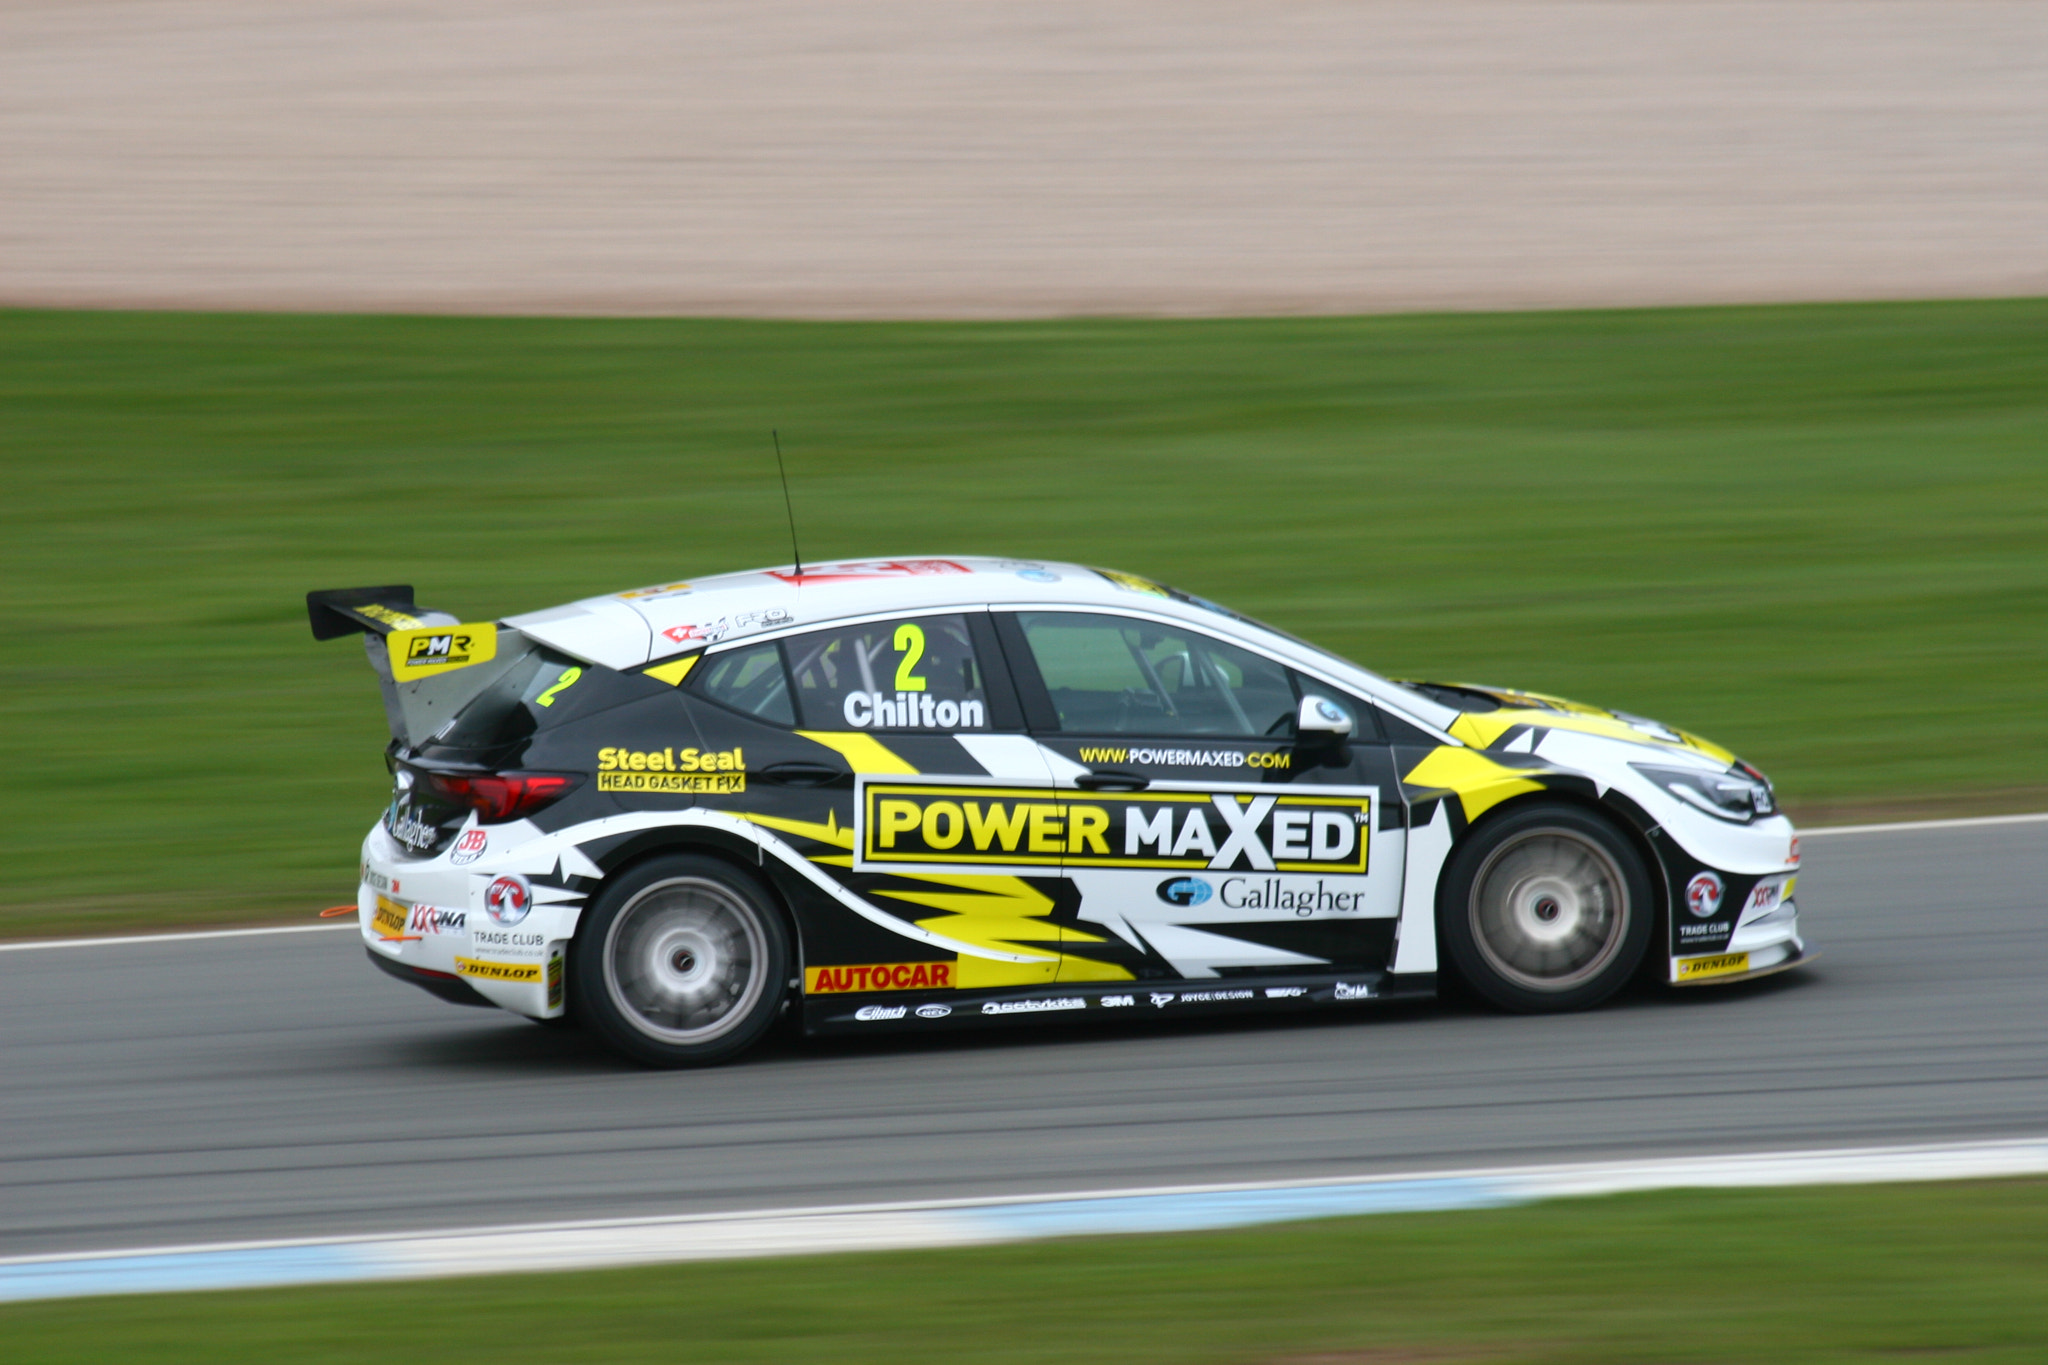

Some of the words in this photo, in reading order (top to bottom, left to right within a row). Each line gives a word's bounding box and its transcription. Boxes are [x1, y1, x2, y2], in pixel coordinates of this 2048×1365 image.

[409, 635, 472, 657] PMR
[894, 623, 927, 692] 2
[535, 666, 582, 708] 2
[843, 691, 984, 727] Chilton
[598, 747, 676, 772] Steel
[680, 747, 746, 772] Seal
[600, 774, 645, 788] HEAD
[648, 775, 712, 790] GASKET
[716, 776, 742, 791] FIX
[879, 799, 1111, 855] POWER
[1124, 794, 1355, 871] MAXED
[1219, 877, 1366, 917] Gallagher
[474, 930, 508, 945] TRADE
[512, 933, 544, 946] CLUB
[1680, 925, 1707, 936] TRADE
[1709, 921, 1730, 934] CLUB
[468, 964, 538, 979] DUNLOP
[1691, 956, 1745, 972] DUNLOP
[814, 964, 950, 992] AUTOCAR
[1100, 995, 1136, 1008] 3M
